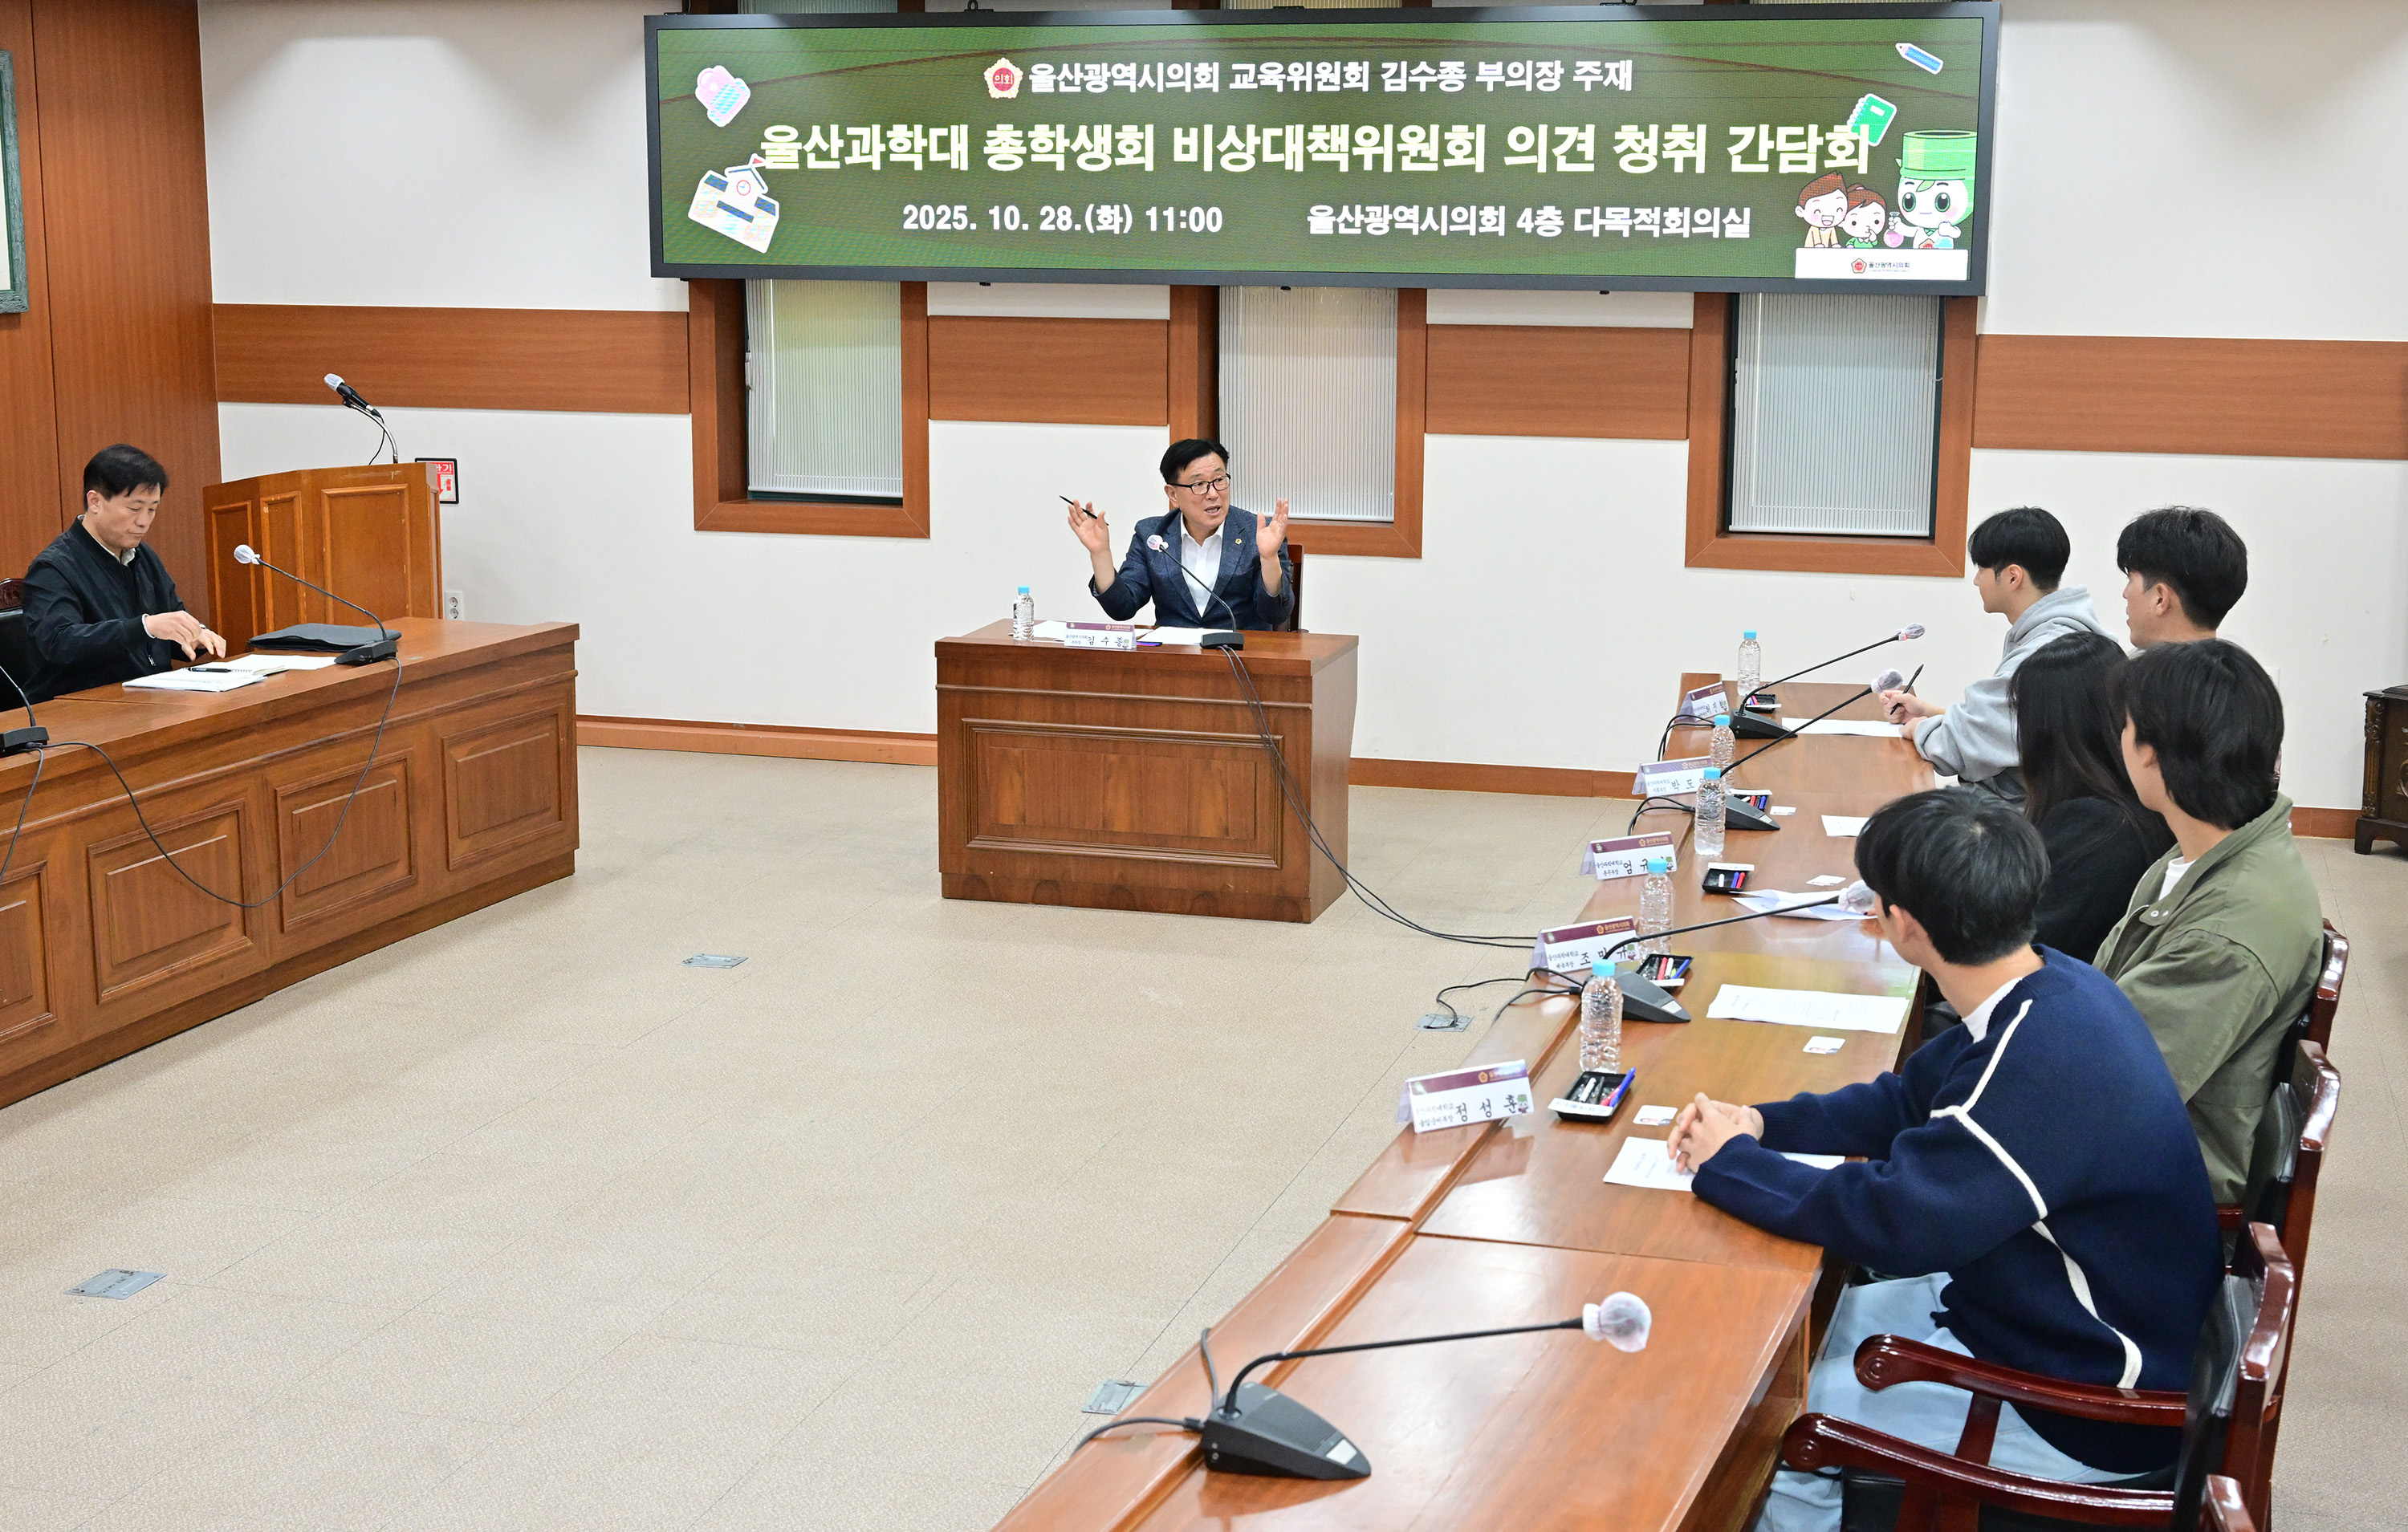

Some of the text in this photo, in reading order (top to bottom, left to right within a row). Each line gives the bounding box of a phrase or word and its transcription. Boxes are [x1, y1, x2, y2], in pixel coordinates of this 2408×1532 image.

[1028, 59, 1633, 94] 울산광역시의회 교육위원회 김수종 부의장 주재
[759, 124, 1869, 174] 울산과학대 총학생회 비상대책위원회 의견 청취 간담회
[903, 203, 1223, 234] 2025. 10. 28.(화) 11:00
[1307, 204, 1751, 238] 울산광역시의회 4층 다목적회의실
